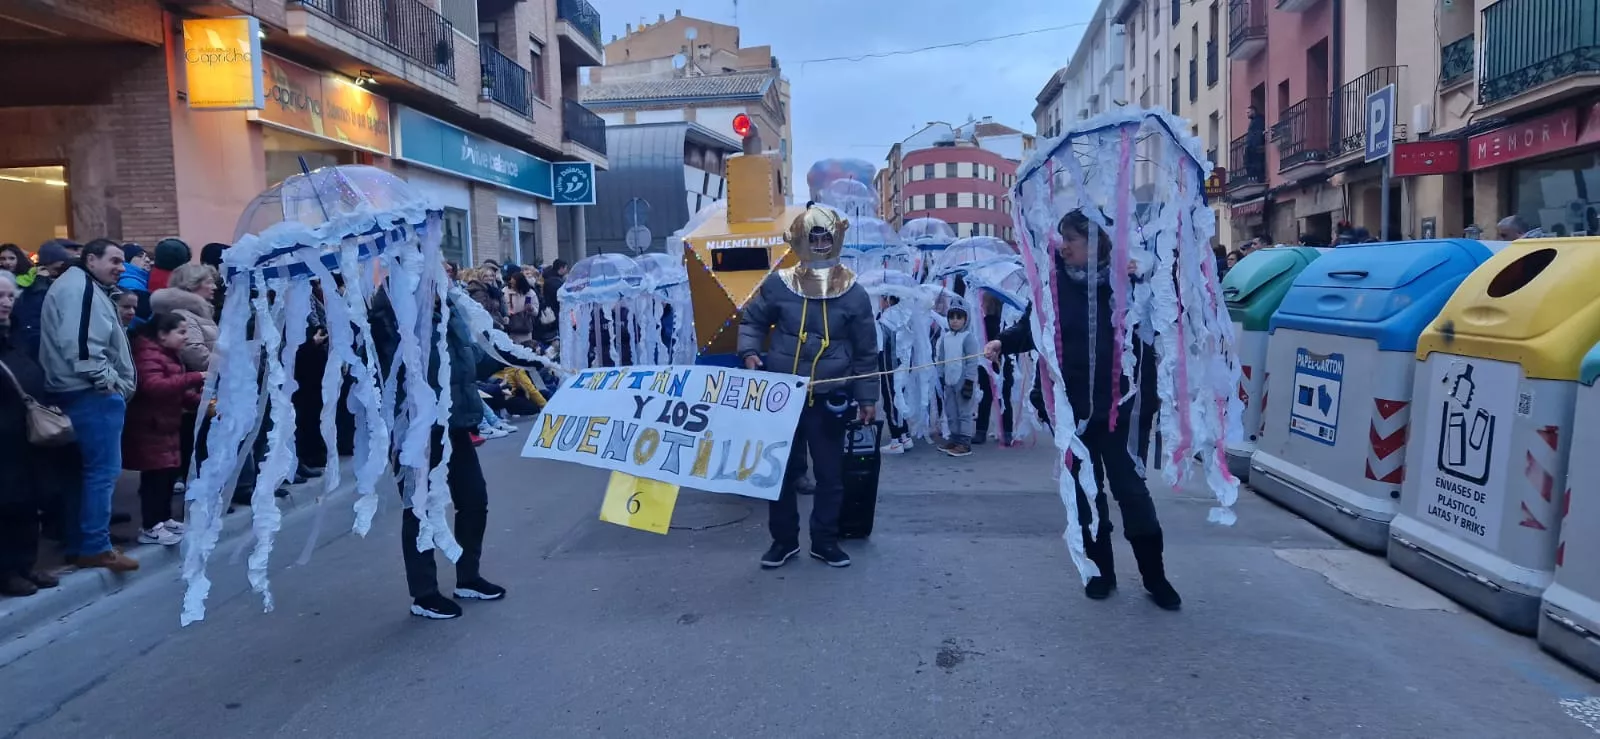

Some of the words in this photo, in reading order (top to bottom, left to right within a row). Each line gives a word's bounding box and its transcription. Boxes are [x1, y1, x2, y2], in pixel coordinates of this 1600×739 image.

[185, 47, 252, 67] Capricho
[1369, 98, 1386, 153] P
[1478, 118, 1570, 160] MEMORY
[489, 151, 519, 179] balance
[560, 166, 588, 179] balance
[706, 236, 785, 250] NUENOTILUS
[701, 370, 791, 413] NEMO
[633, 395, 655, 419] Y
[656, 399, 713, 432] LOS
[533, 413, 788, 489] NUENOTILUS
[627, 491, 645, 515] 6
[1435, 477, 1472, 499] ENVASES
[1474, 490, 1487, 504] DE
[1428, 504, 1452, 522] LATAS
[1453, 514, 1460, 525] Y
[1460, 518, 1486, 537] BRIKS
